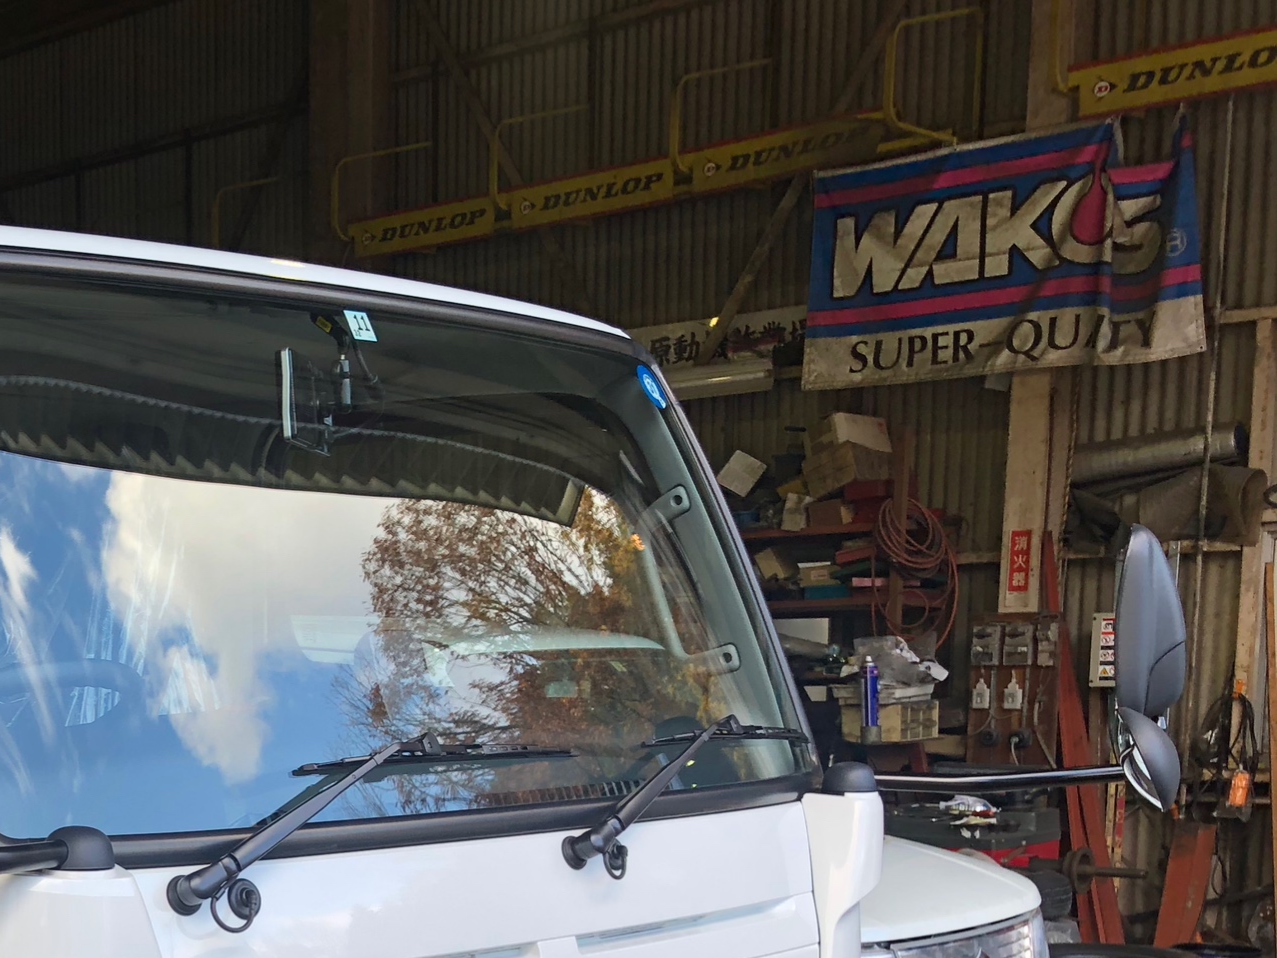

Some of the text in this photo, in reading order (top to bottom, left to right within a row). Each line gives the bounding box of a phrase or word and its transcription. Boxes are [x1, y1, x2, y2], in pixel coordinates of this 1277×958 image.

[539, 172, 665, 212] DUNLOP
[379, 208, 488, 243] DUNLOP
[1012, 536, 1028, 587] 消火器
